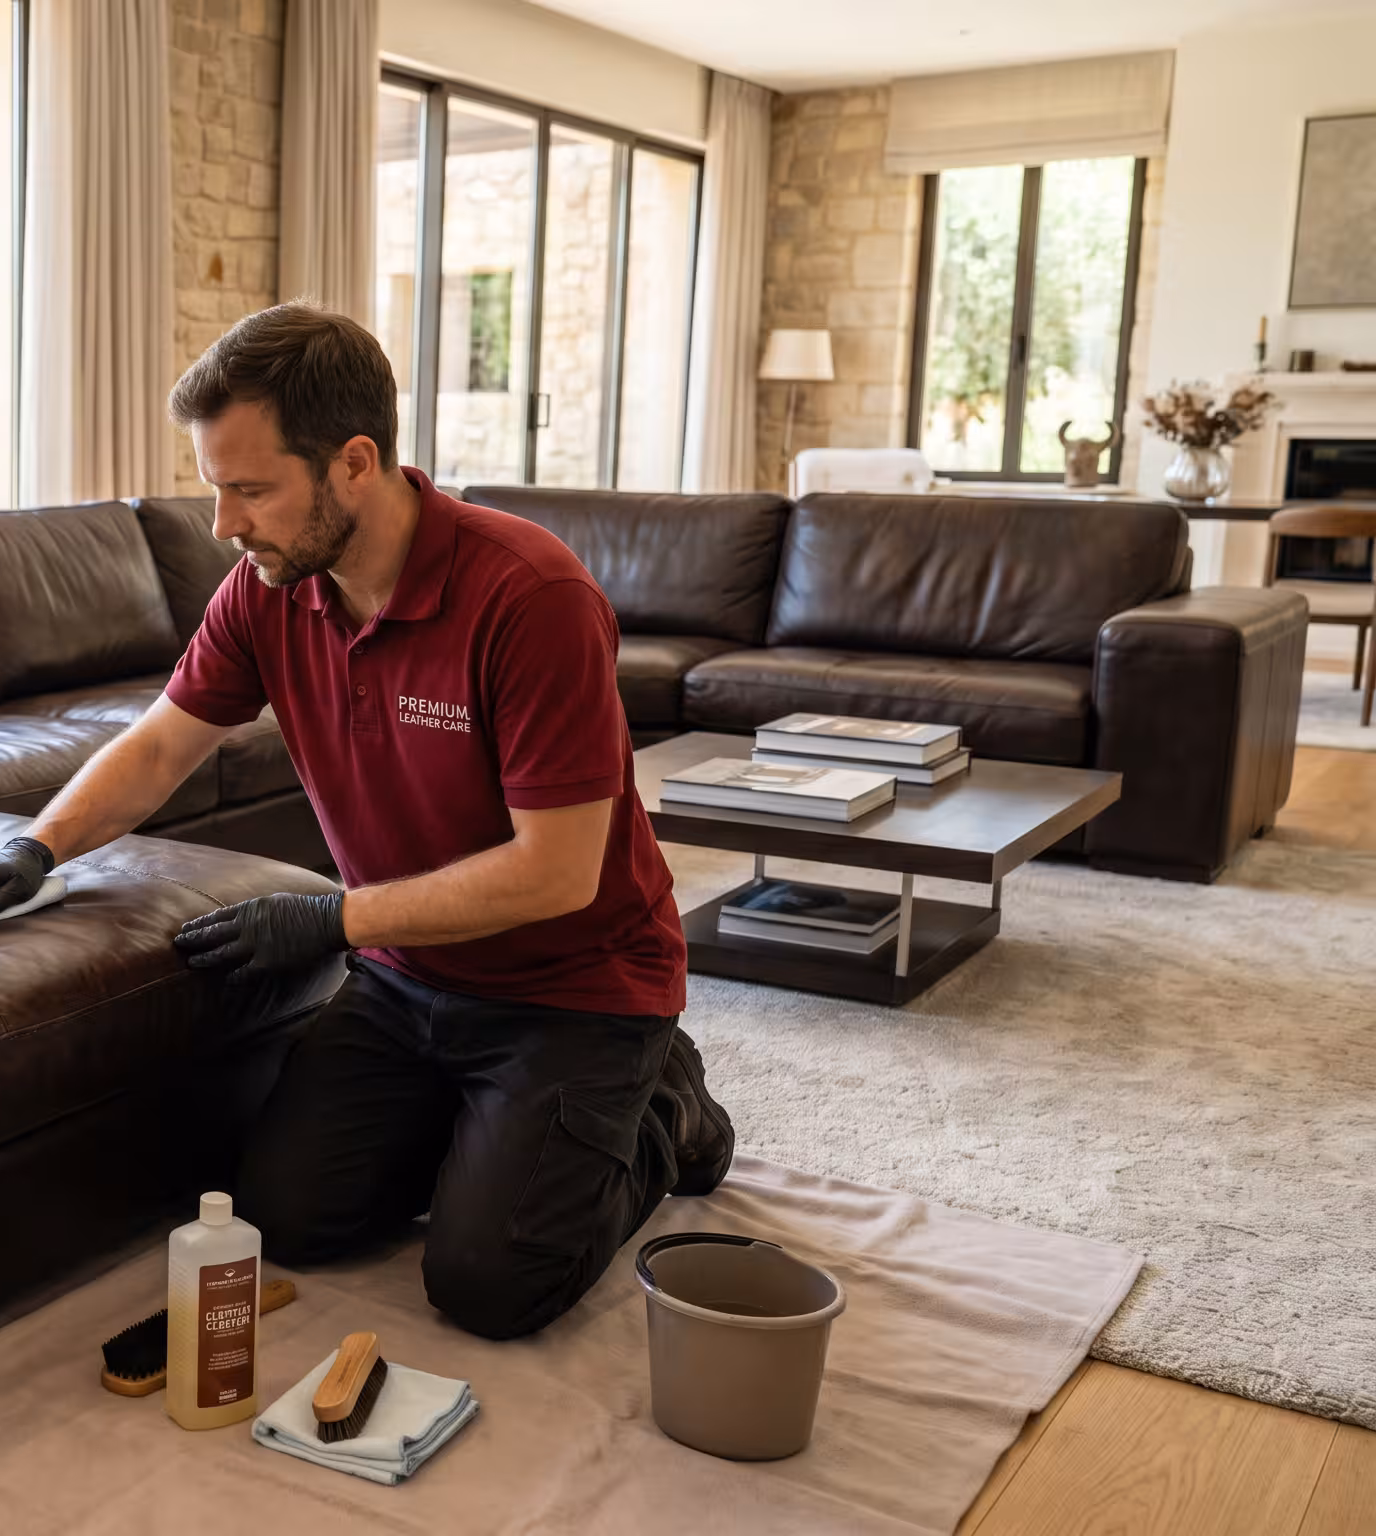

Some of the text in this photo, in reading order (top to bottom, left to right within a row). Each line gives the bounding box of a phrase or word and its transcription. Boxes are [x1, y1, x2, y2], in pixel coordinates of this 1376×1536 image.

[399, 696, 471, 720] PREMIUM
[399, 712, 471, 733] LEATHER CARE
